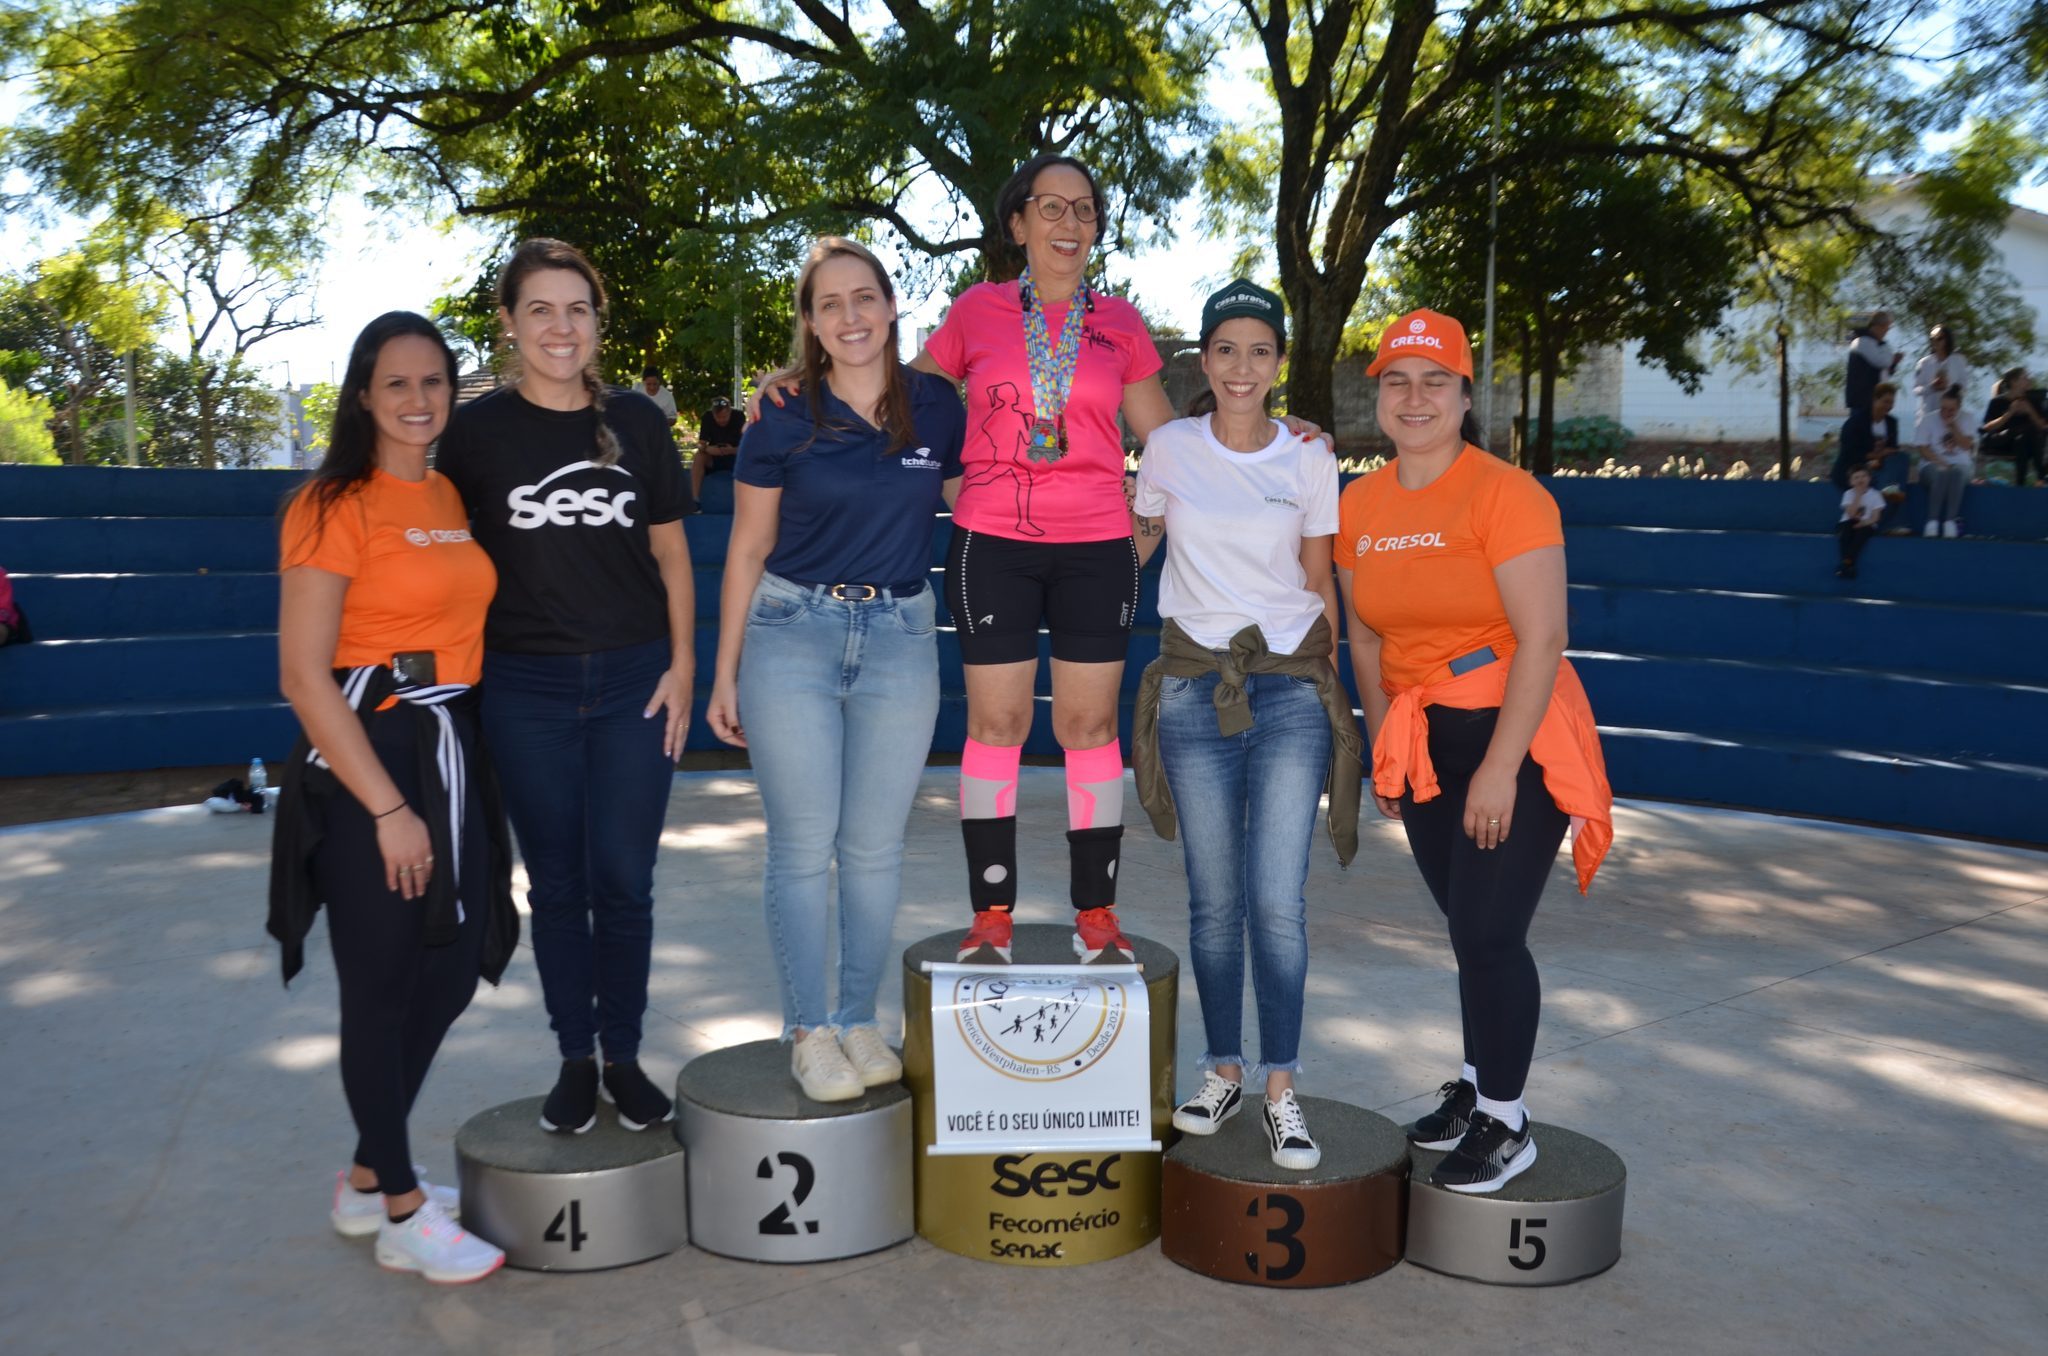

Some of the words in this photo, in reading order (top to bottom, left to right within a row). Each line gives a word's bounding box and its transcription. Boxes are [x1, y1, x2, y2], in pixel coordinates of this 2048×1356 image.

[1214, 295, 1236, 311] Casa
[1237, 293, 1272, 311] Branca
[1390, 335, 1444, 350] CRESOL
[1374, 532, 1446, 552] CRESOL
[960, 997, 984, 1046] Federico
[1086, 1030, 1113, 1058] Desde
[1107, 1002, 1121, 1031] 202
[948, 1111, 983, 1131] VOCÊ
[987, 1110, 996, 1131] É
[999, 1113, 1008, 1131] O
[1012, 1112, 1039, 1130] SEU
[1043, 1108, 1085, 1129] ÚNICO
[1089, 1110, 1140, 1128] LIMITE!
[757, 1152, 819, 1235] 2
[543, 1200, 588, 1252] 4
[989, 1208, 1121, 1234] Fecomércio
[1246, 1193, 1306, 1281] 3
[990, 1239, 1063, 1259] Senac
[1508, 1218, 1548, 1271] 5
